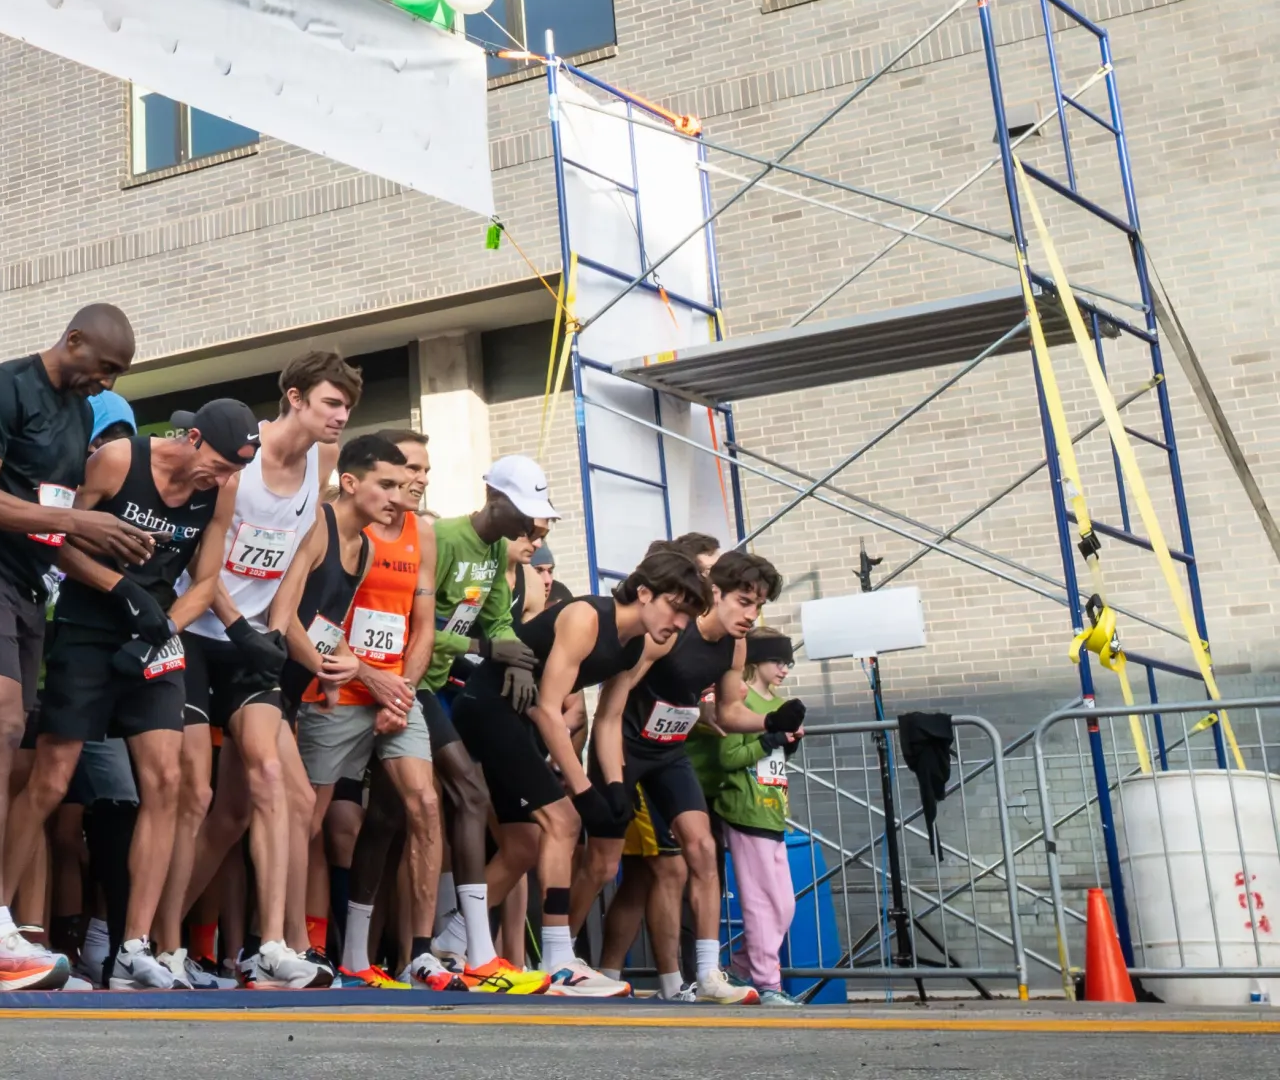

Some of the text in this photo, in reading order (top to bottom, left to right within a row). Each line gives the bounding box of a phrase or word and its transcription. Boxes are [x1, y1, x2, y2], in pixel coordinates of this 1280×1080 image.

[120, 500, 201, 541] Behringer
[239, 544, 285, 568] 7757
[249, 569, 267, 577] 2025
[363, 628, 394, 651] 326
[369, 651, 386, 660] 2025
[165, 658, 182, 670] 2025
[654, 718, 689, 734] 5136
